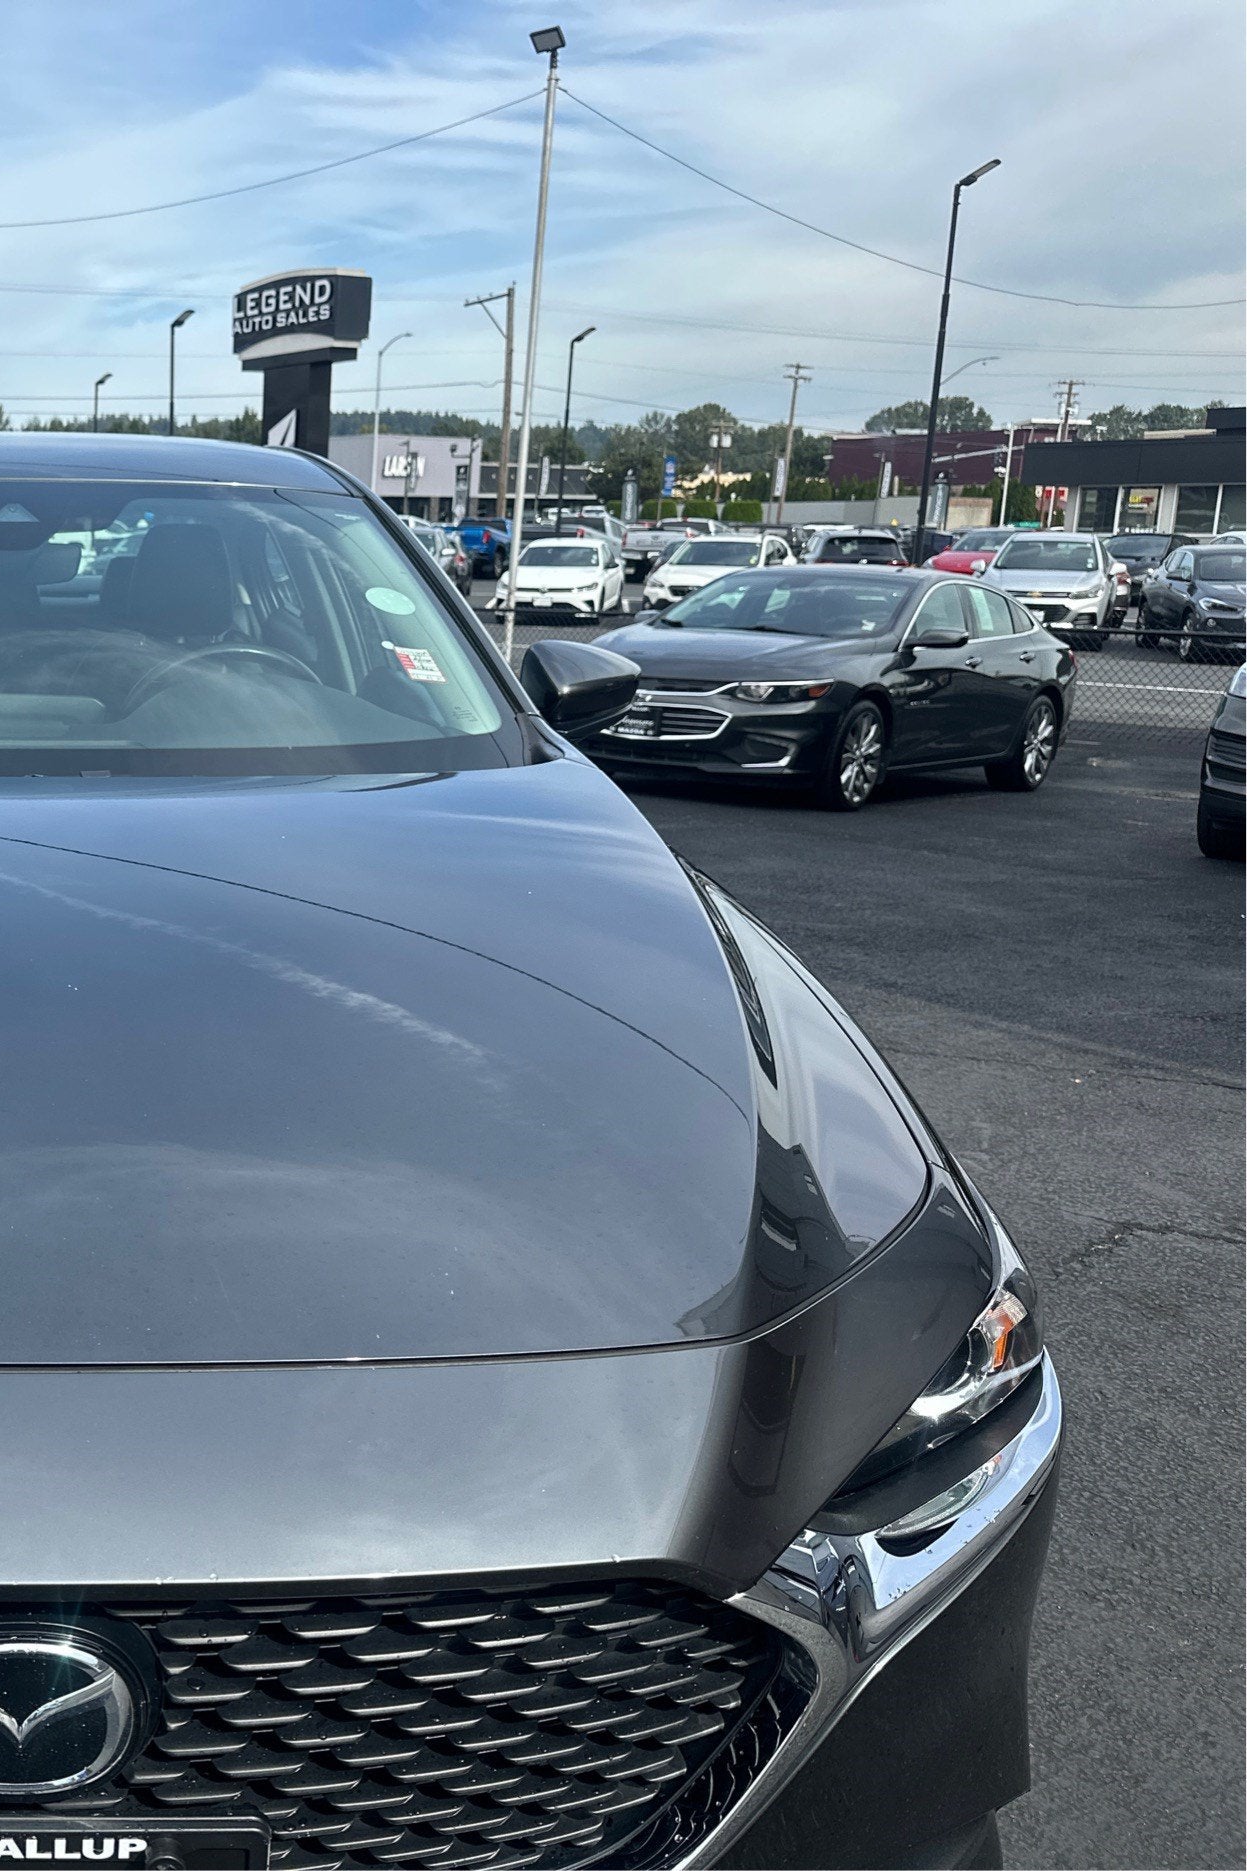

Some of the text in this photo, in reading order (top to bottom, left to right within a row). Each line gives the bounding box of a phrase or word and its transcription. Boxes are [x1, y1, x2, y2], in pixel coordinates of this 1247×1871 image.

[233, 279, 331, 319] LEGEND
[233, 304, 330, 334] AUTO SALES
